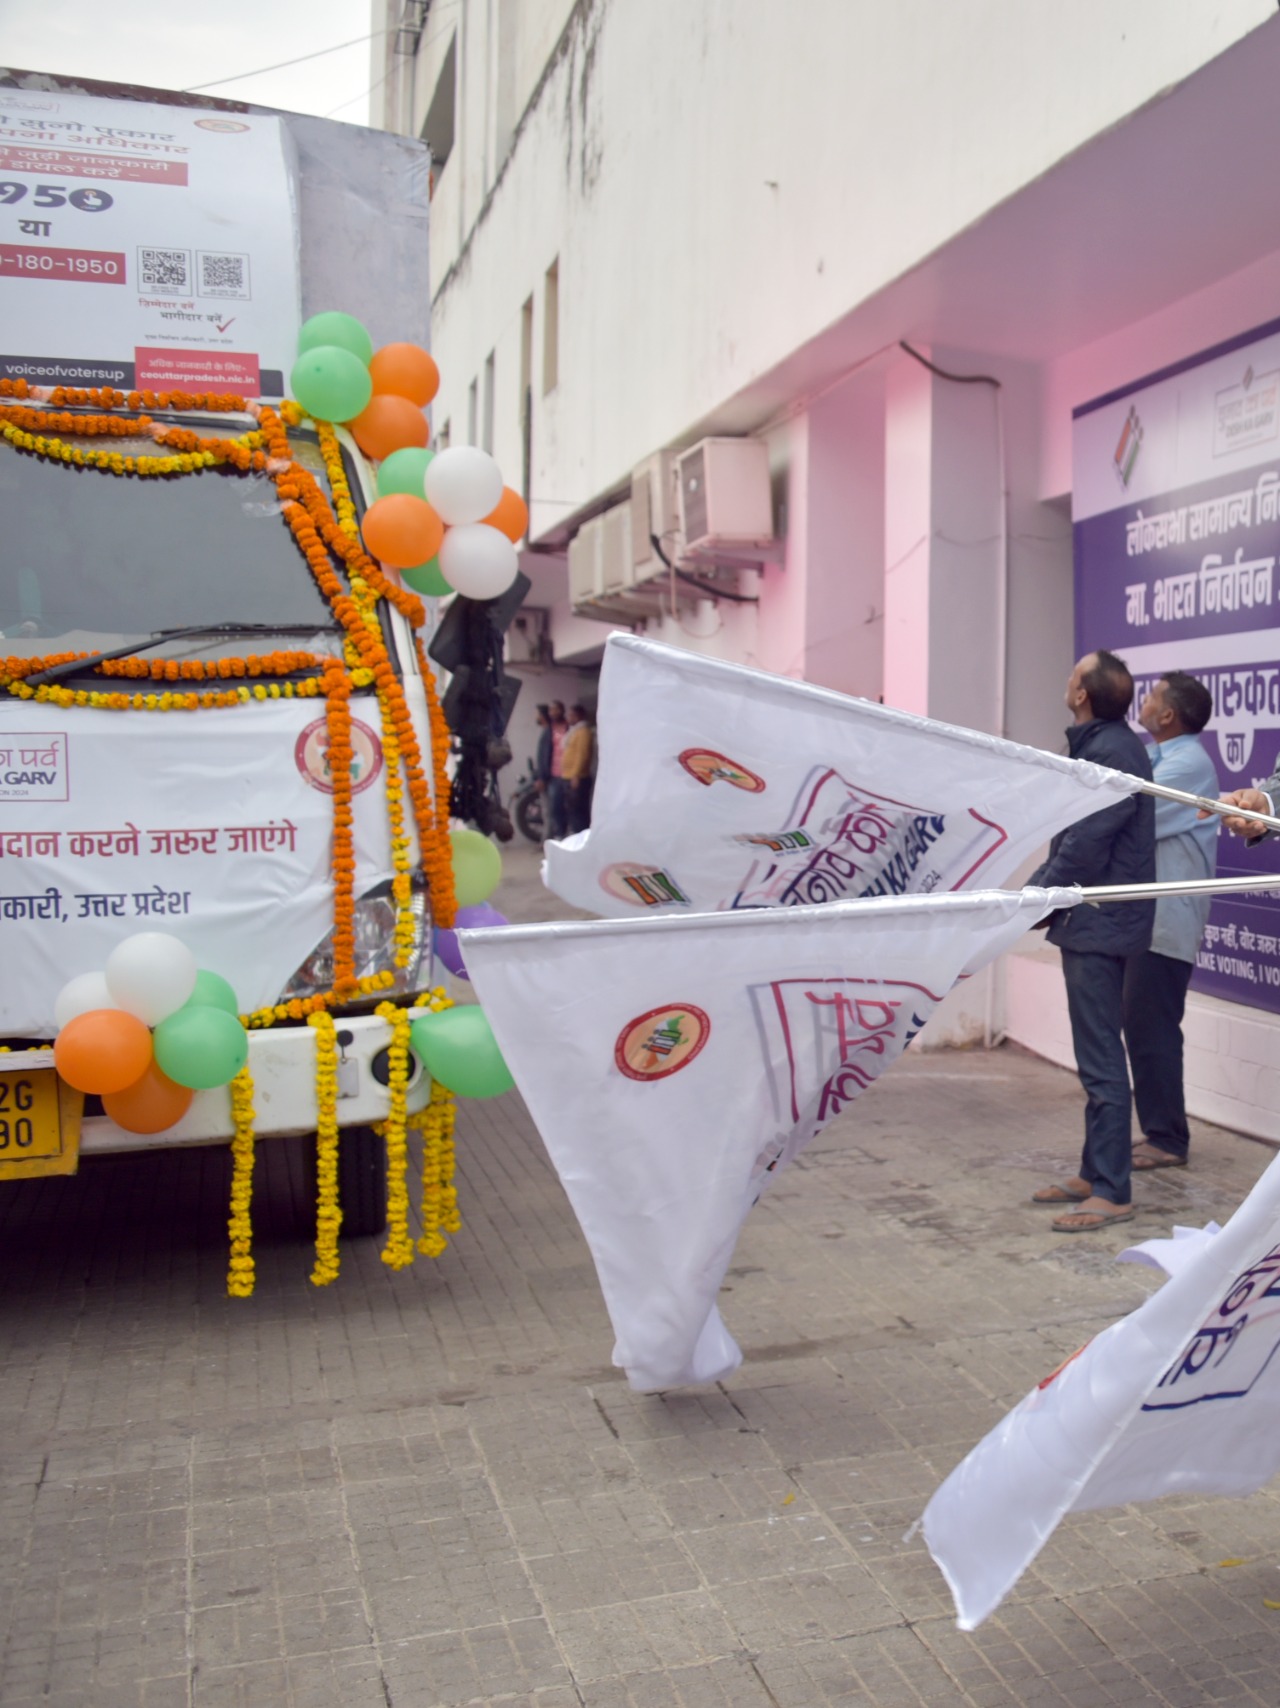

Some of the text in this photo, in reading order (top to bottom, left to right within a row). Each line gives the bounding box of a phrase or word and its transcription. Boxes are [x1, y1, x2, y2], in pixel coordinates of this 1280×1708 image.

[67, 134, 191, 154] अधिकार
[10, 160, 77, 173] डायल
[67, 154, 170, 171] जानकारी
[18, 219, 52, 237] या
[0, 254, 118, 275] -180-1950
[5, 363, 125, 382] voiceofvotersup
[140, 370, 256, 384] ceouttarpradesh.nic.in
[1126, 509, 1188, 557] लोकसभा
[1189, 488, 1253, 542] सामान्य
[1126, 582, 1150, 627] मा.
[1153, 571, 1199, 622] भारत
[1199, 547, 1276, 616] निर्वाचन
[19, 740, 60, 768] पर्व
[1225, 733, 1246, 765] का
[4, 771, 57, 785] GARV
[0, 818, 298, 858] दान करने जरूर जाएंगे
[0, 885, 191, 923] कारी, उत्तर प्रदेश
[1196, 951, 1217, 971] LIKE
[1216, 955, 1258, 984] VOTING,
